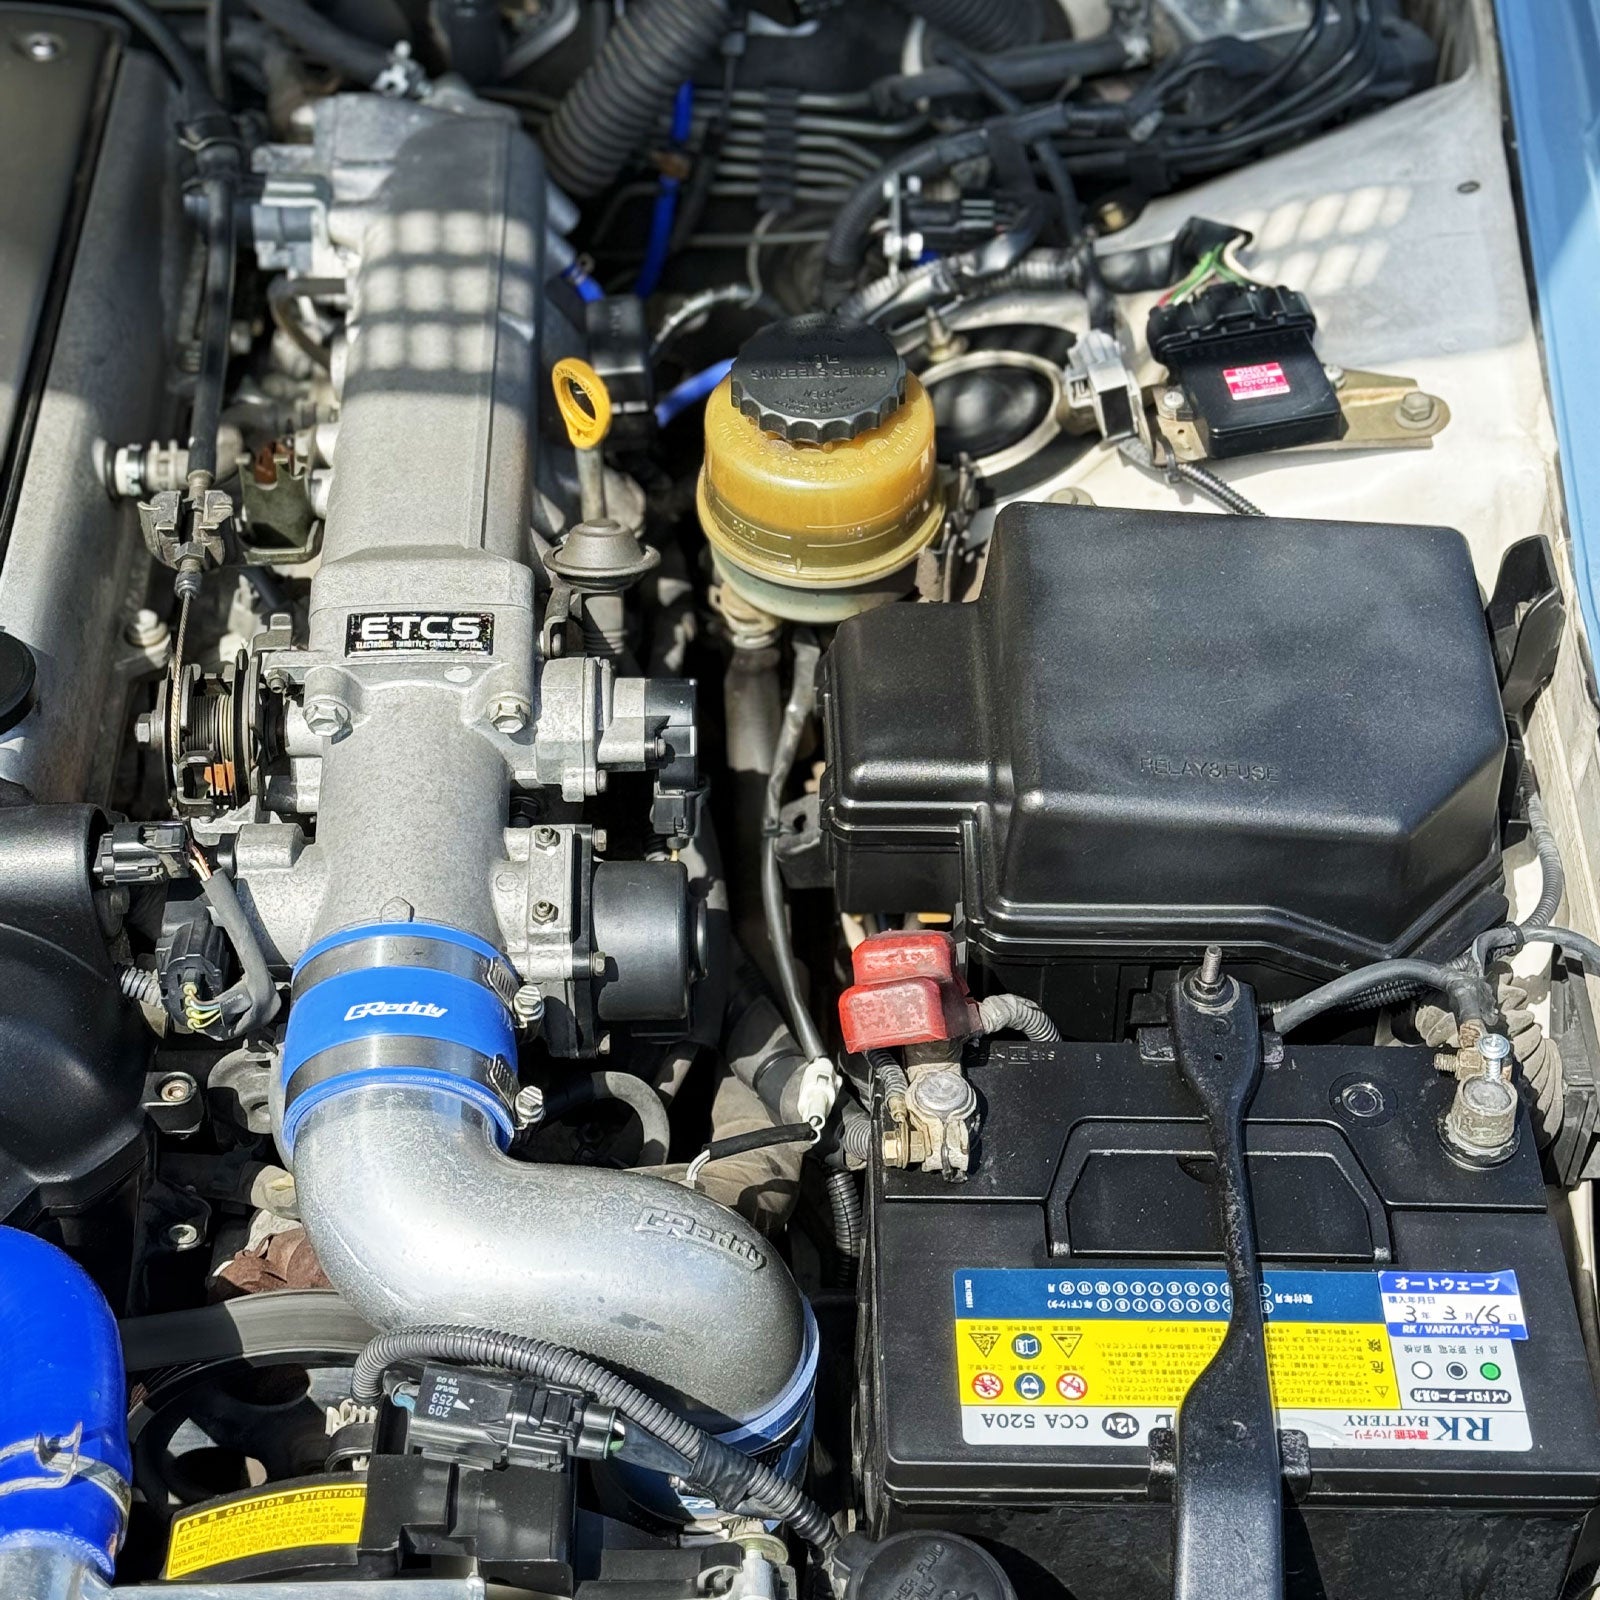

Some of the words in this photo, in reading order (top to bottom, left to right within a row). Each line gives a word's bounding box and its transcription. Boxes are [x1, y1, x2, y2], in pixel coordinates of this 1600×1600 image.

[750, 368, 826, 380] STEERING
[834, 367, 886, 378] POWER
[1238, 376, 1277, 387] TOYOTA
[361, 616, 481, 640] ETCS
[344, 1001, 448, 1021] GReddy
[634, 1206, 767, 1271] GReddy
[1395, 1277, 1500, 1292] オートウェーブ
[1274, 1292, 1313, 1304] 取付年月
[1388, 1295, 1436, 1304] 購入年月日
[1404, 1305, 1417, 1323] 3
[1421, 1311, 1430, 1320] 年
[1443, 1305, 1457, 1320] 3
[1465, 1312, 1474, 1320] 月
[1508, 1313, 1517, 1321] 日
[1402, 1325, 1417, 1334] RK
[432, 1392, 454, 1406] 253
[1414, 1389, 1509, 1402] ハイドロメーターの見方
[428, 1404, 450, 1418] 209
[980, 1413, 1036, 1428] 520A
[1044, 1413, 1088, 1429] CCA
[1344, 1415, 1429, 1426] BATTERY
[1433, 1416, 1492, 1442] RK
[226, 1497, 285, 1516] CAUTION
[293, 1489, 361, 1502] ATTENTION
[916, 1543, 946, 1577] FLUID
